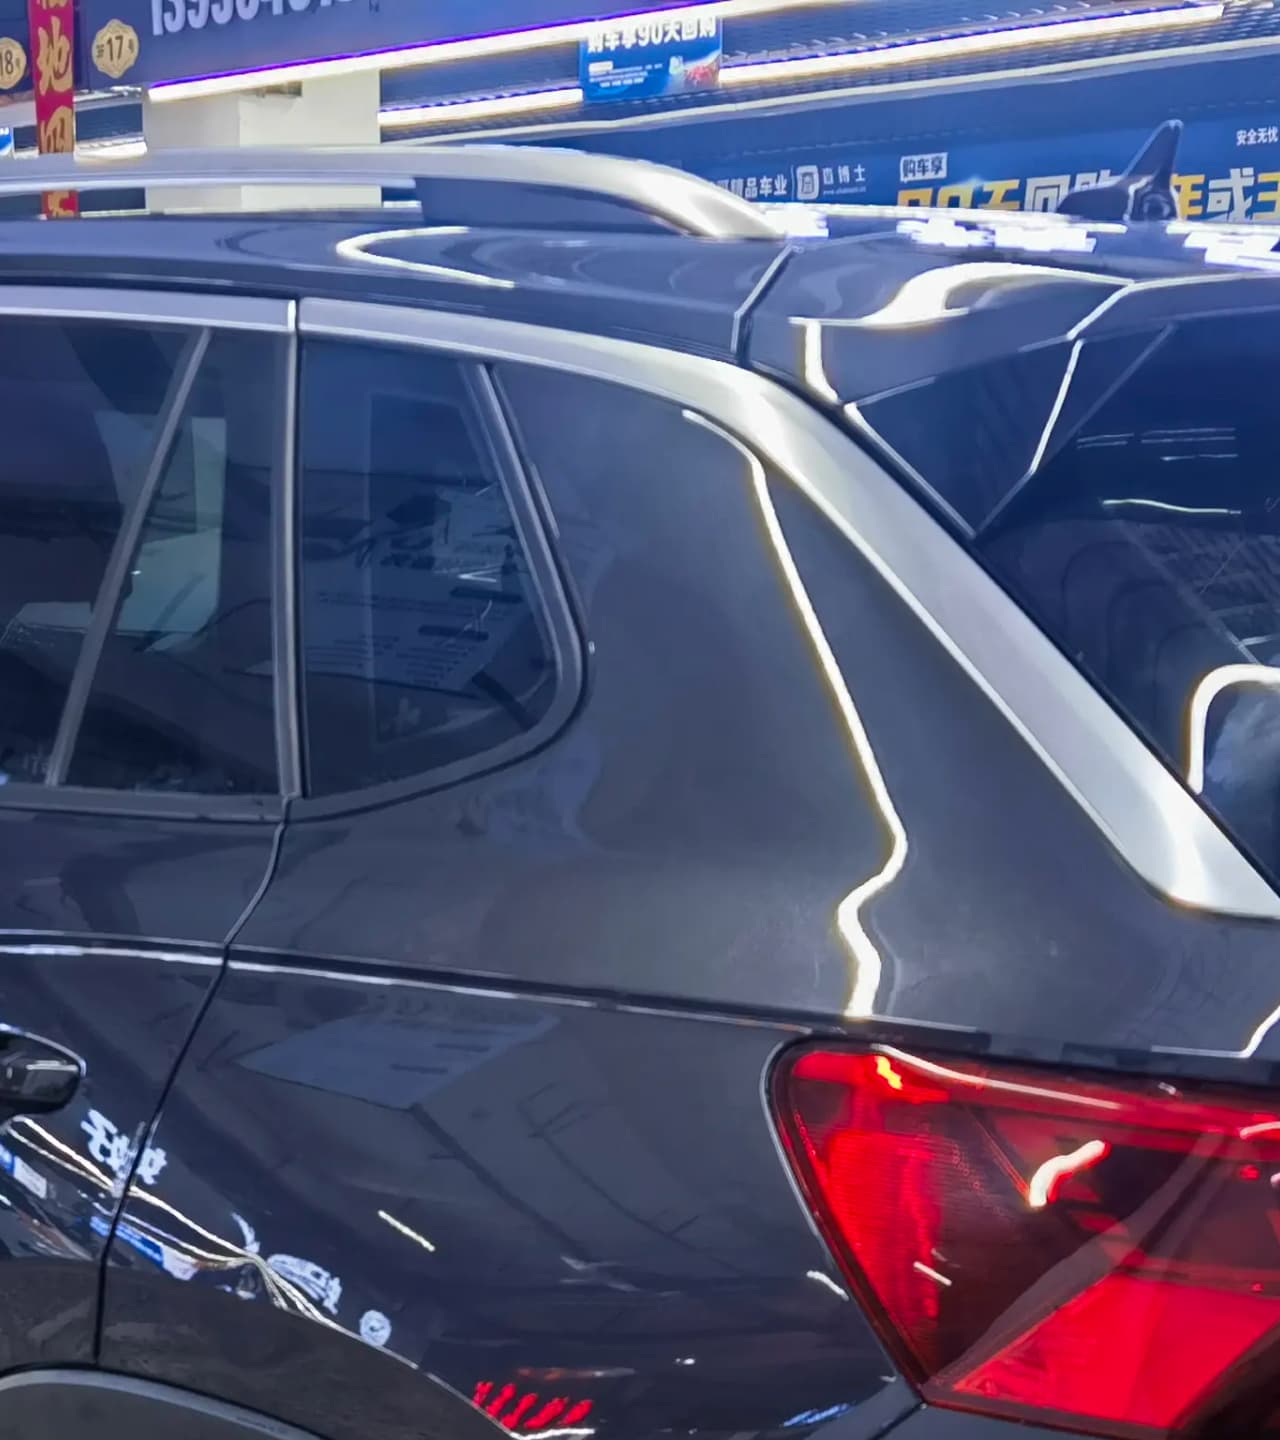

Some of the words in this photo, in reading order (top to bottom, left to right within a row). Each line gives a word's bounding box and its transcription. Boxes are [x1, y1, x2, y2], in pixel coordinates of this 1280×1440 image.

[1236, 125, 1279, 146] 安全无忧
[903, 156, 944, 178] 购车享
